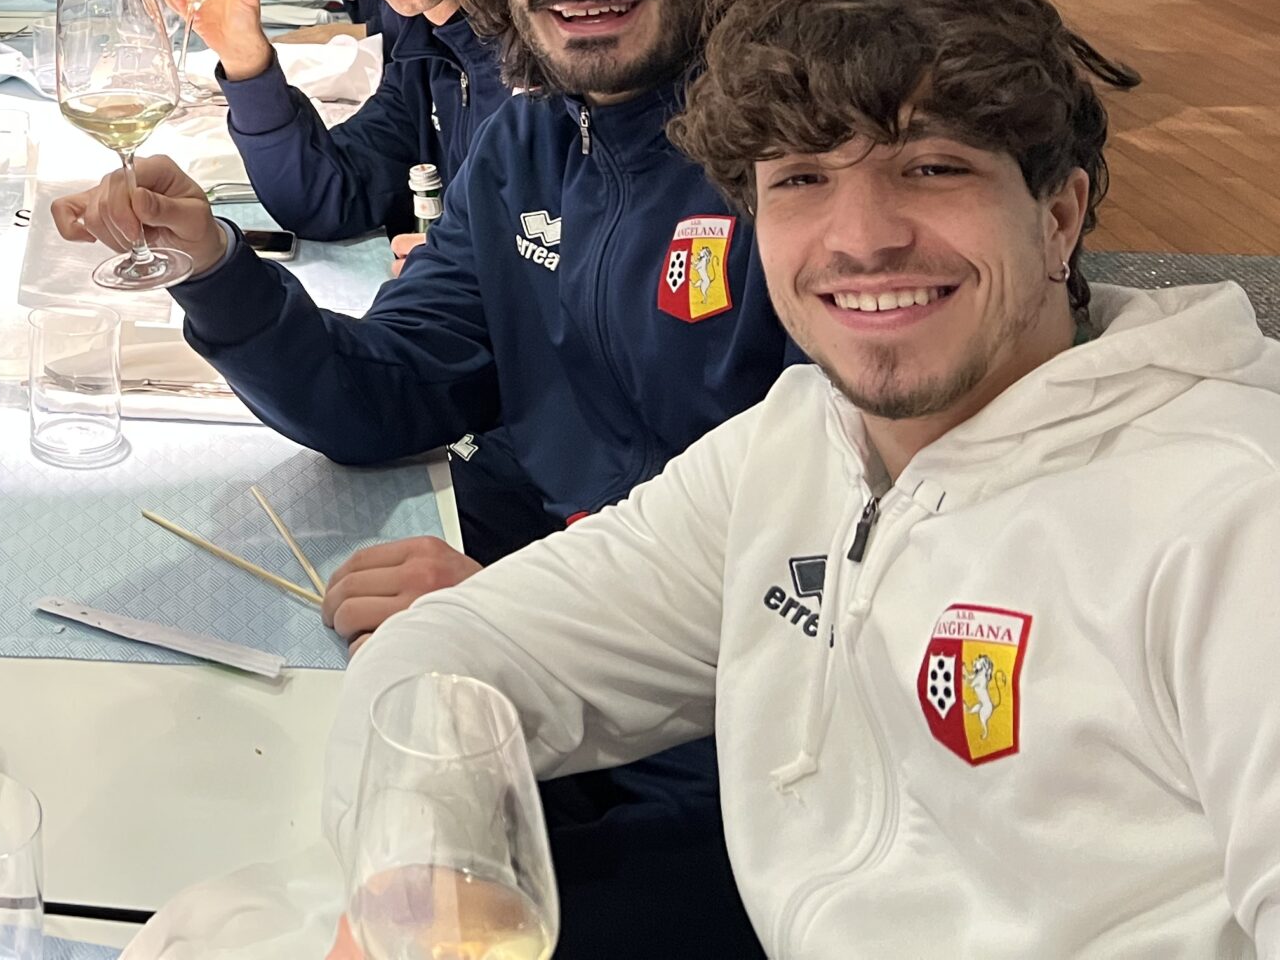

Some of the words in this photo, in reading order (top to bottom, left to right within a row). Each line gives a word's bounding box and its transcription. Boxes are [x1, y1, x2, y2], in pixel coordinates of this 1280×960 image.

[677, 226, 725, 238] ANGELANA
[763, 585, 834, 648] erre
[936, 620, 1013, 642] ANGELANA
